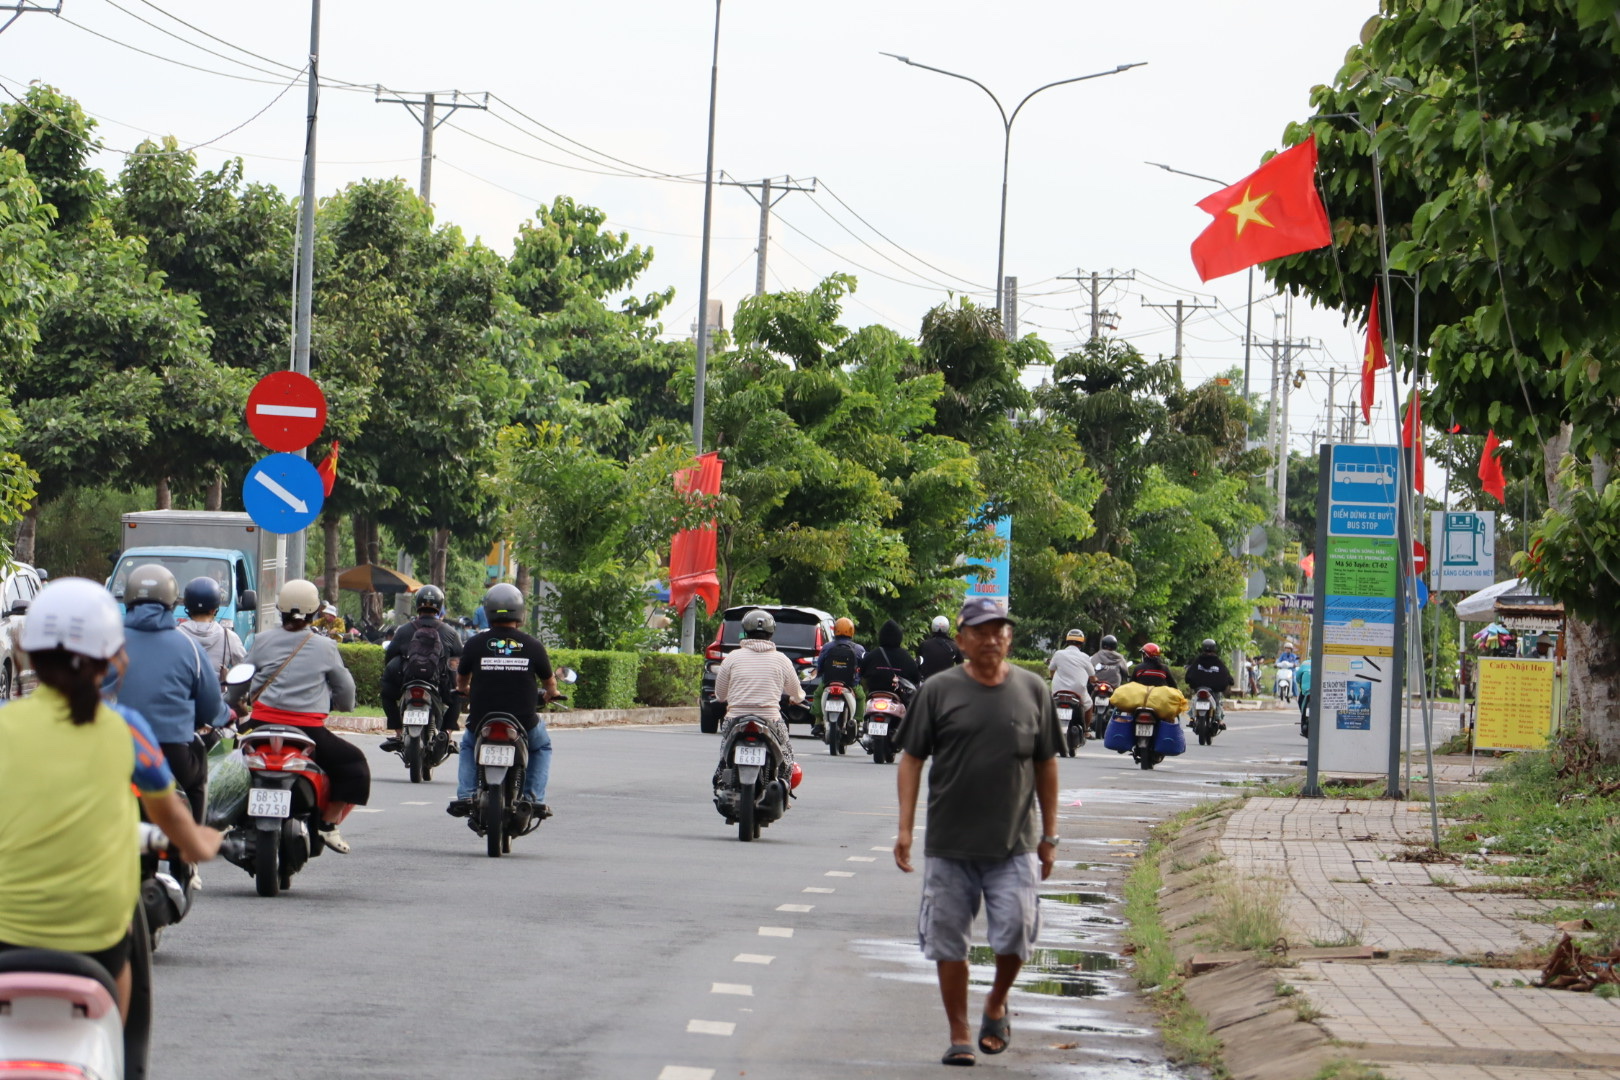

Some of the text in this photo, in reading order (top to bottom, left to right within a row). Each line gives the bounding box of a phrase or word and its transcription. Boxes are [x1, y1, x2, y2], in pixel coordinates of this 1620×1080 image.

[1347, 521, 1378, 530] BUS STOP
[1531, 664, 1546, 673] Huy
[485, 756, 509, 764] 0293
[251, 804, 287, 815] 267.58
